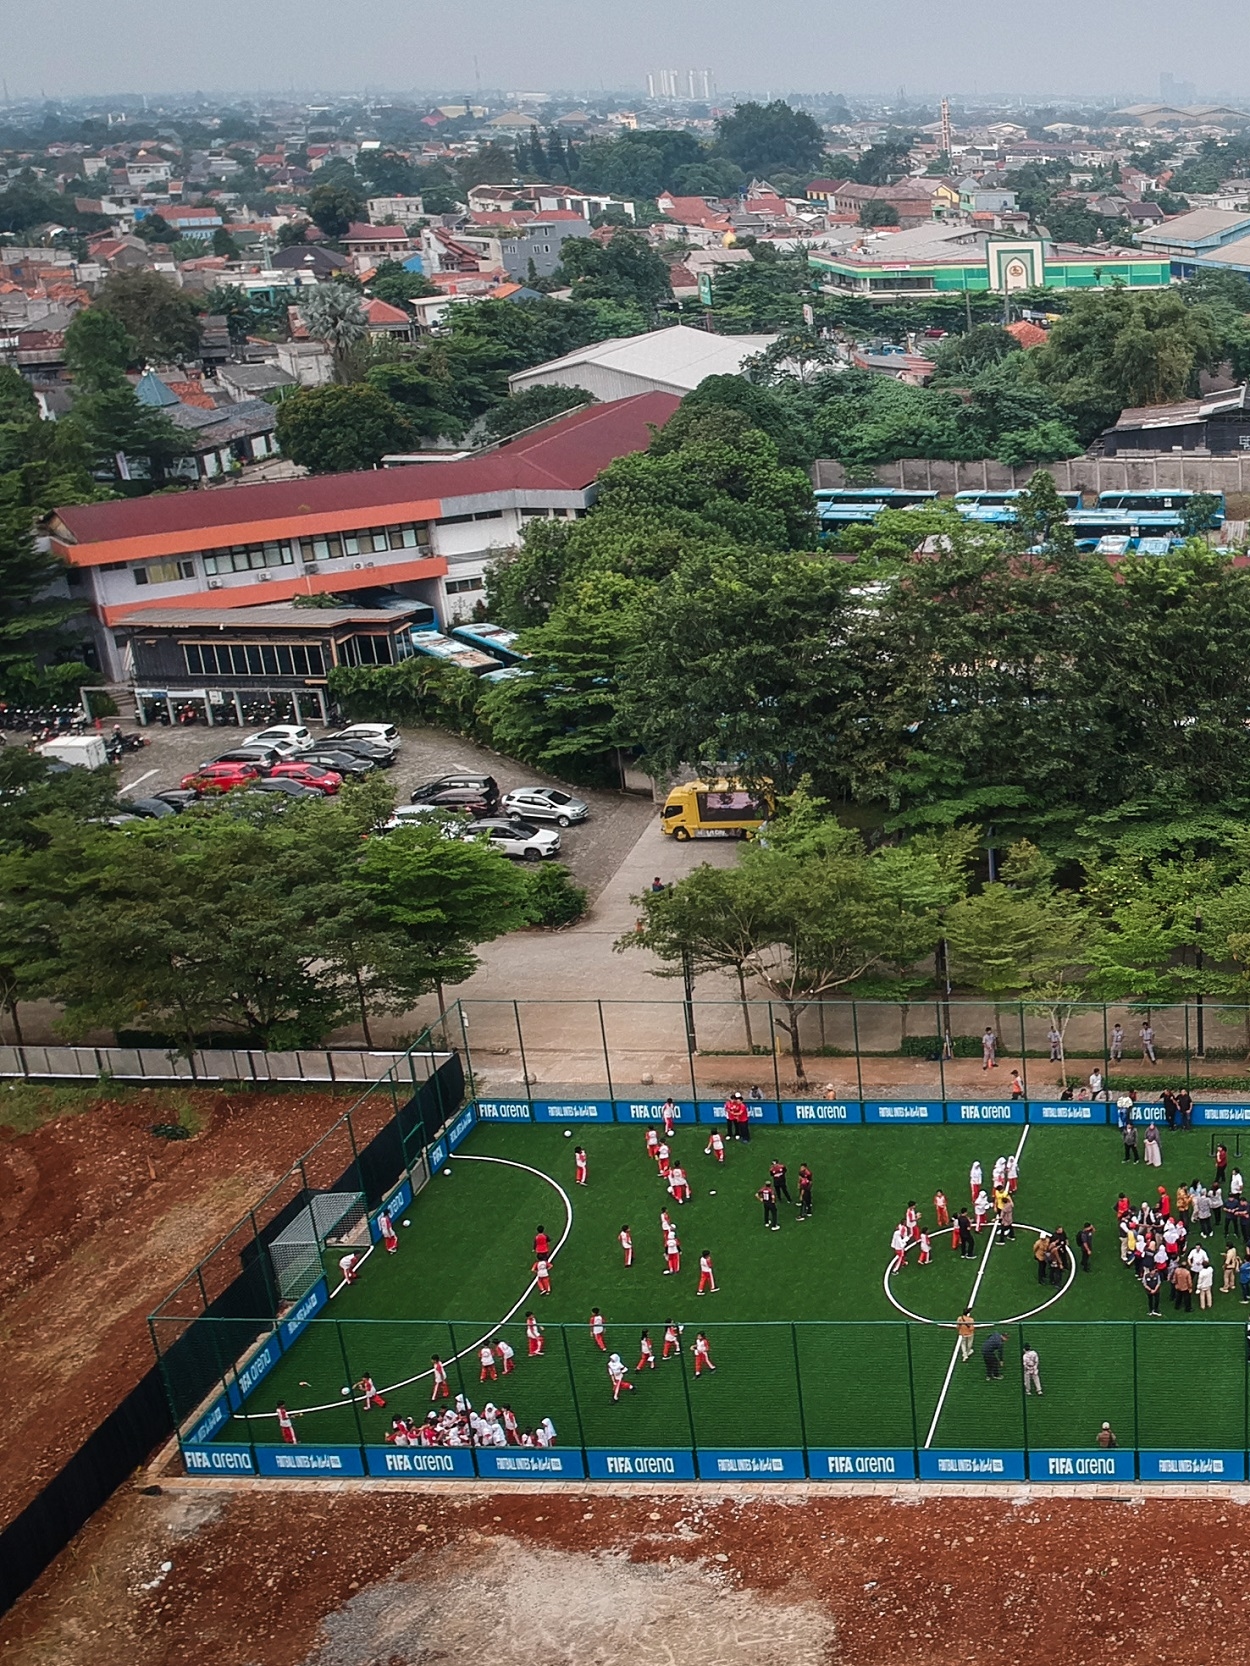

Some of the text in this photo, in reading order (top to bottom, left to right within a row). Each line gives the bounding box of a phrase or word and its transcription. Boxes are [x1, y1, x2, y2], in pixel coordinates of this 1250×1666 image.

[479, 1104, 530, 1118] FIFA arena
[630, 1105, 681, 1118] FIFA ara
[796, 1105, 846, 1119] FIFA arena
[961, 1105, 1010, 1118] FIFA arena
[1143, 1107, 1166, 1120] aren
[250, 1348, 271, 1381] arena
[184, 1452, 252, 1468] FIFA arena
[385, 1454, 454, 1470] FIFA arena
[606, 1457, 674, 1473] FIFA arena
[828, 1456, 895, 1473] FIFA arena
[1048, 1458, 1115, 1474] FIFA arena
